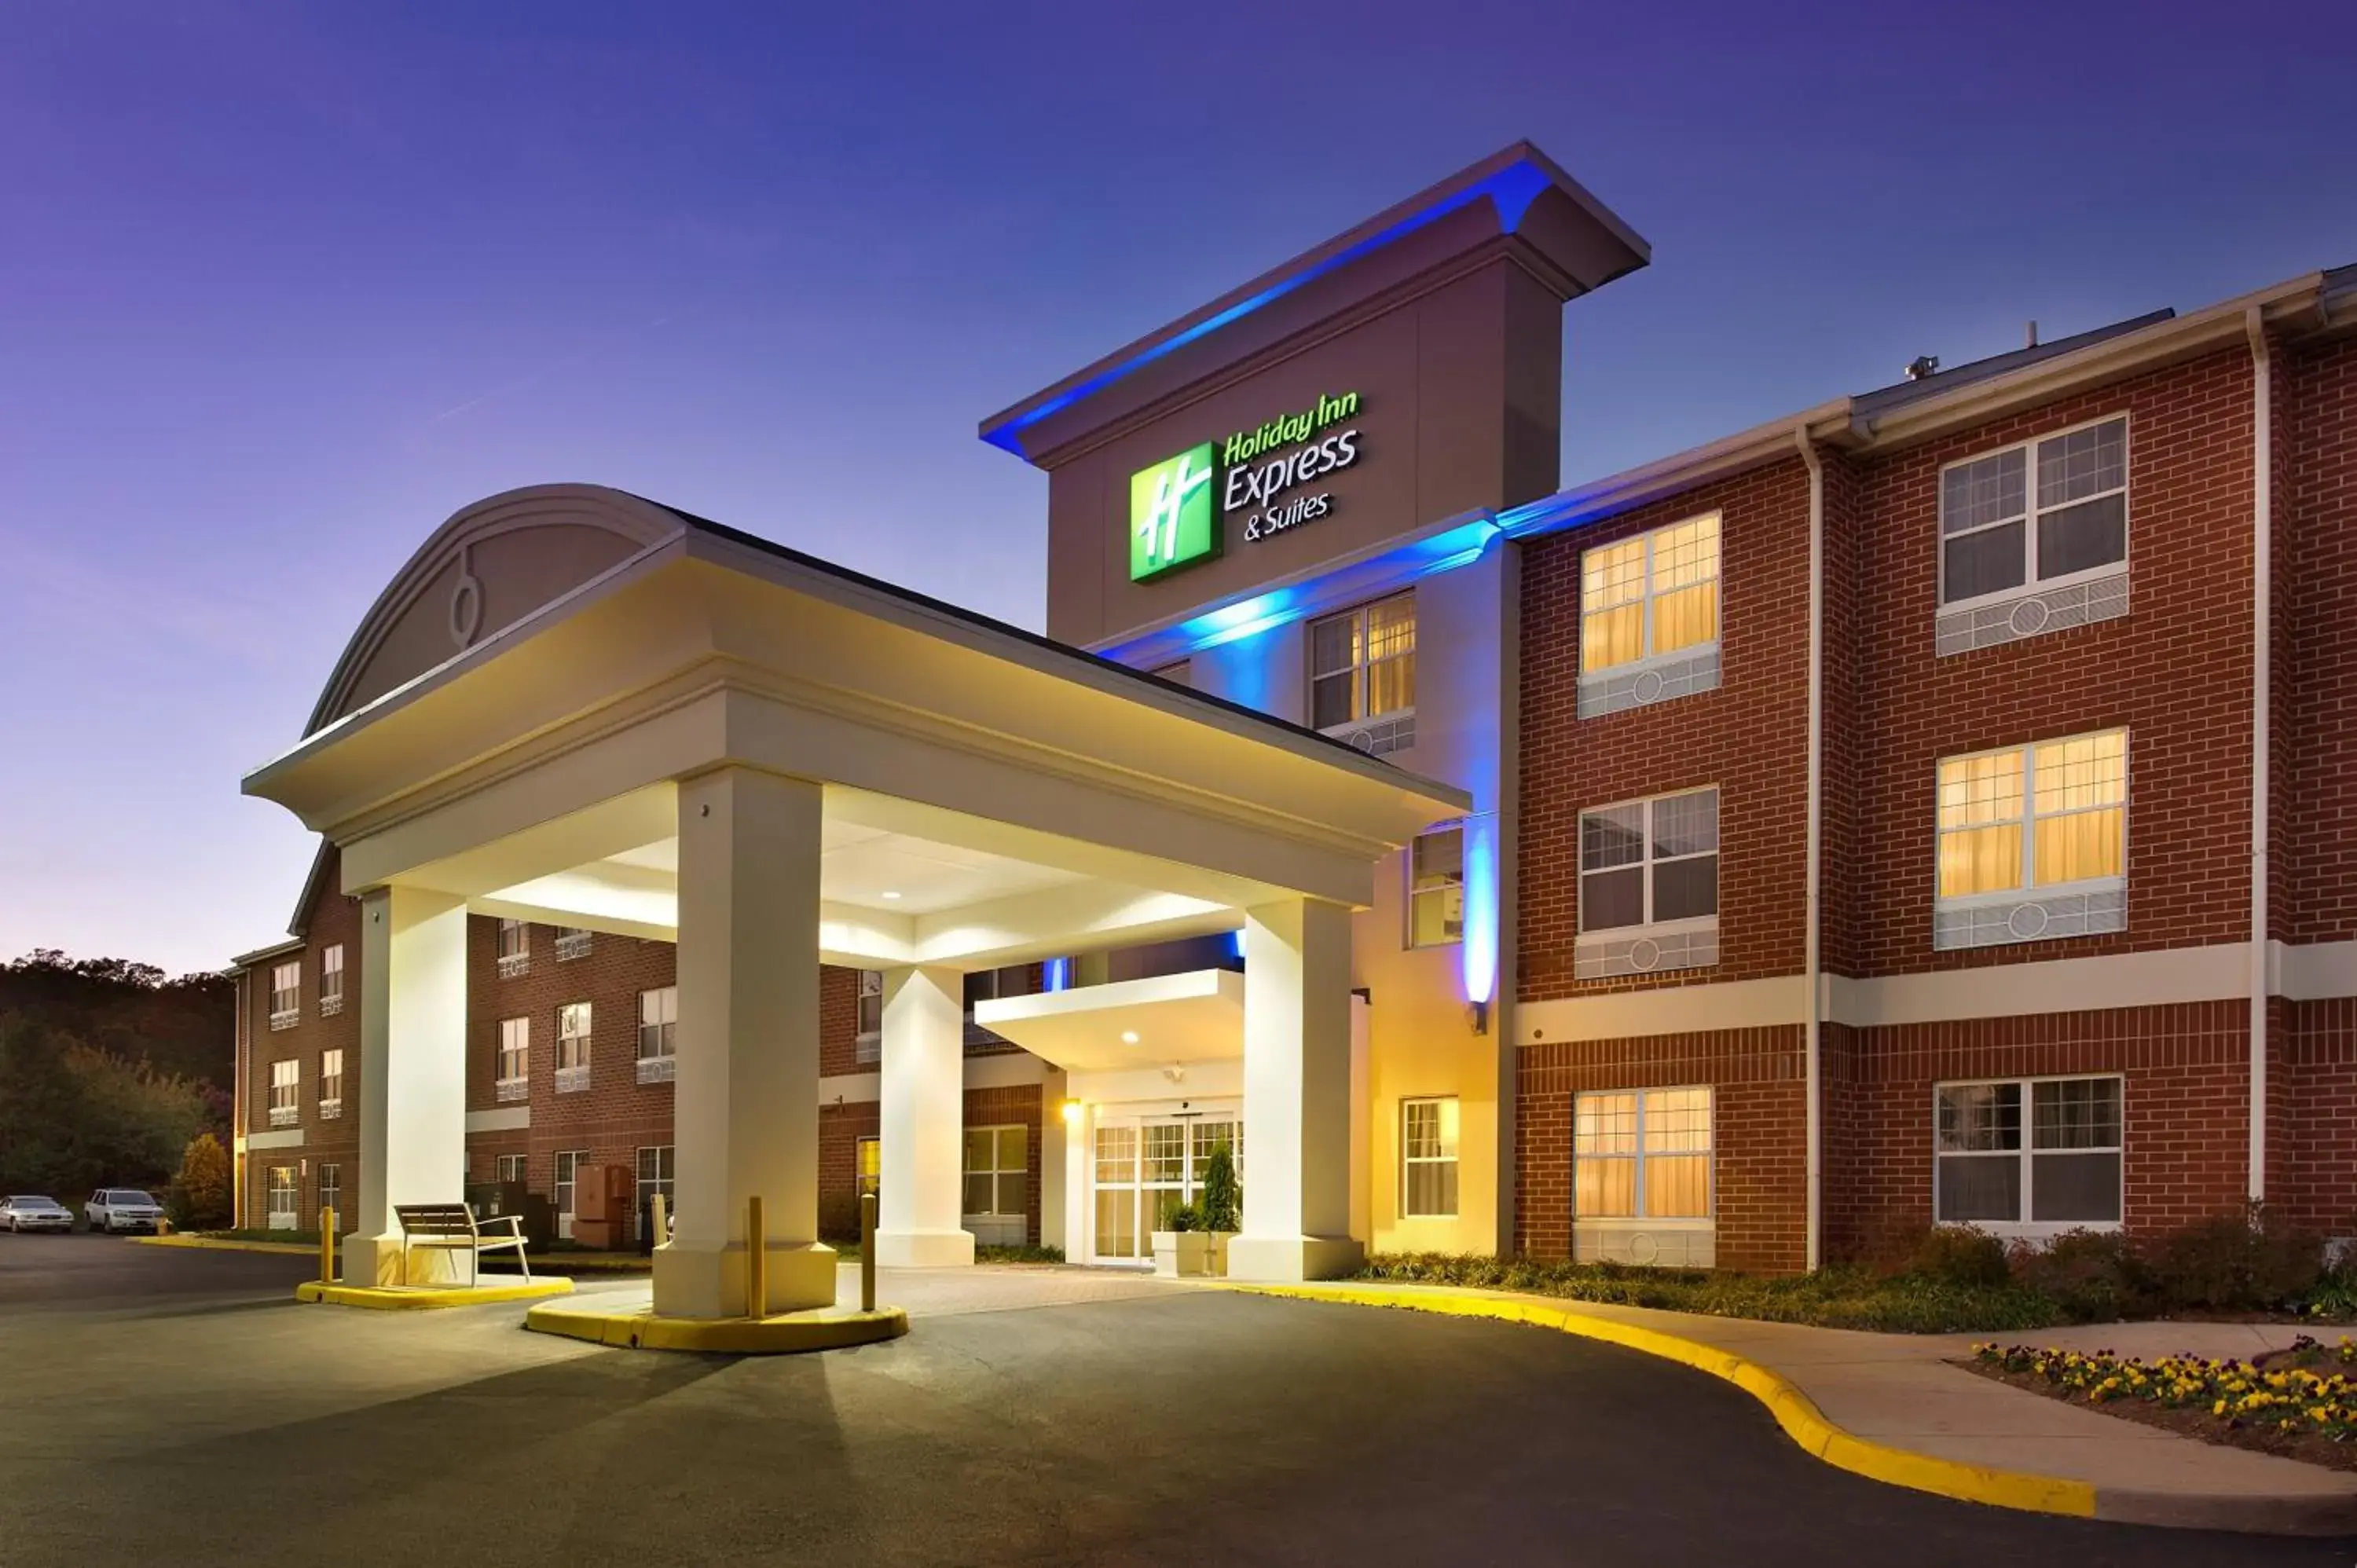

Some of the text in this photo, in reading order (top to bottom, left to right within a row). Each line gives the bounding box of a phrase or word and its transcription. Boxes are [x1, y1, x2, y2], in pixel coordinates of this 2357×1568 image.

[1223, 392, 1358, 467] Holiday Inn
[1223, 430, 1358, 511] Express
[1244, 493, 1329, 541] & Suites
